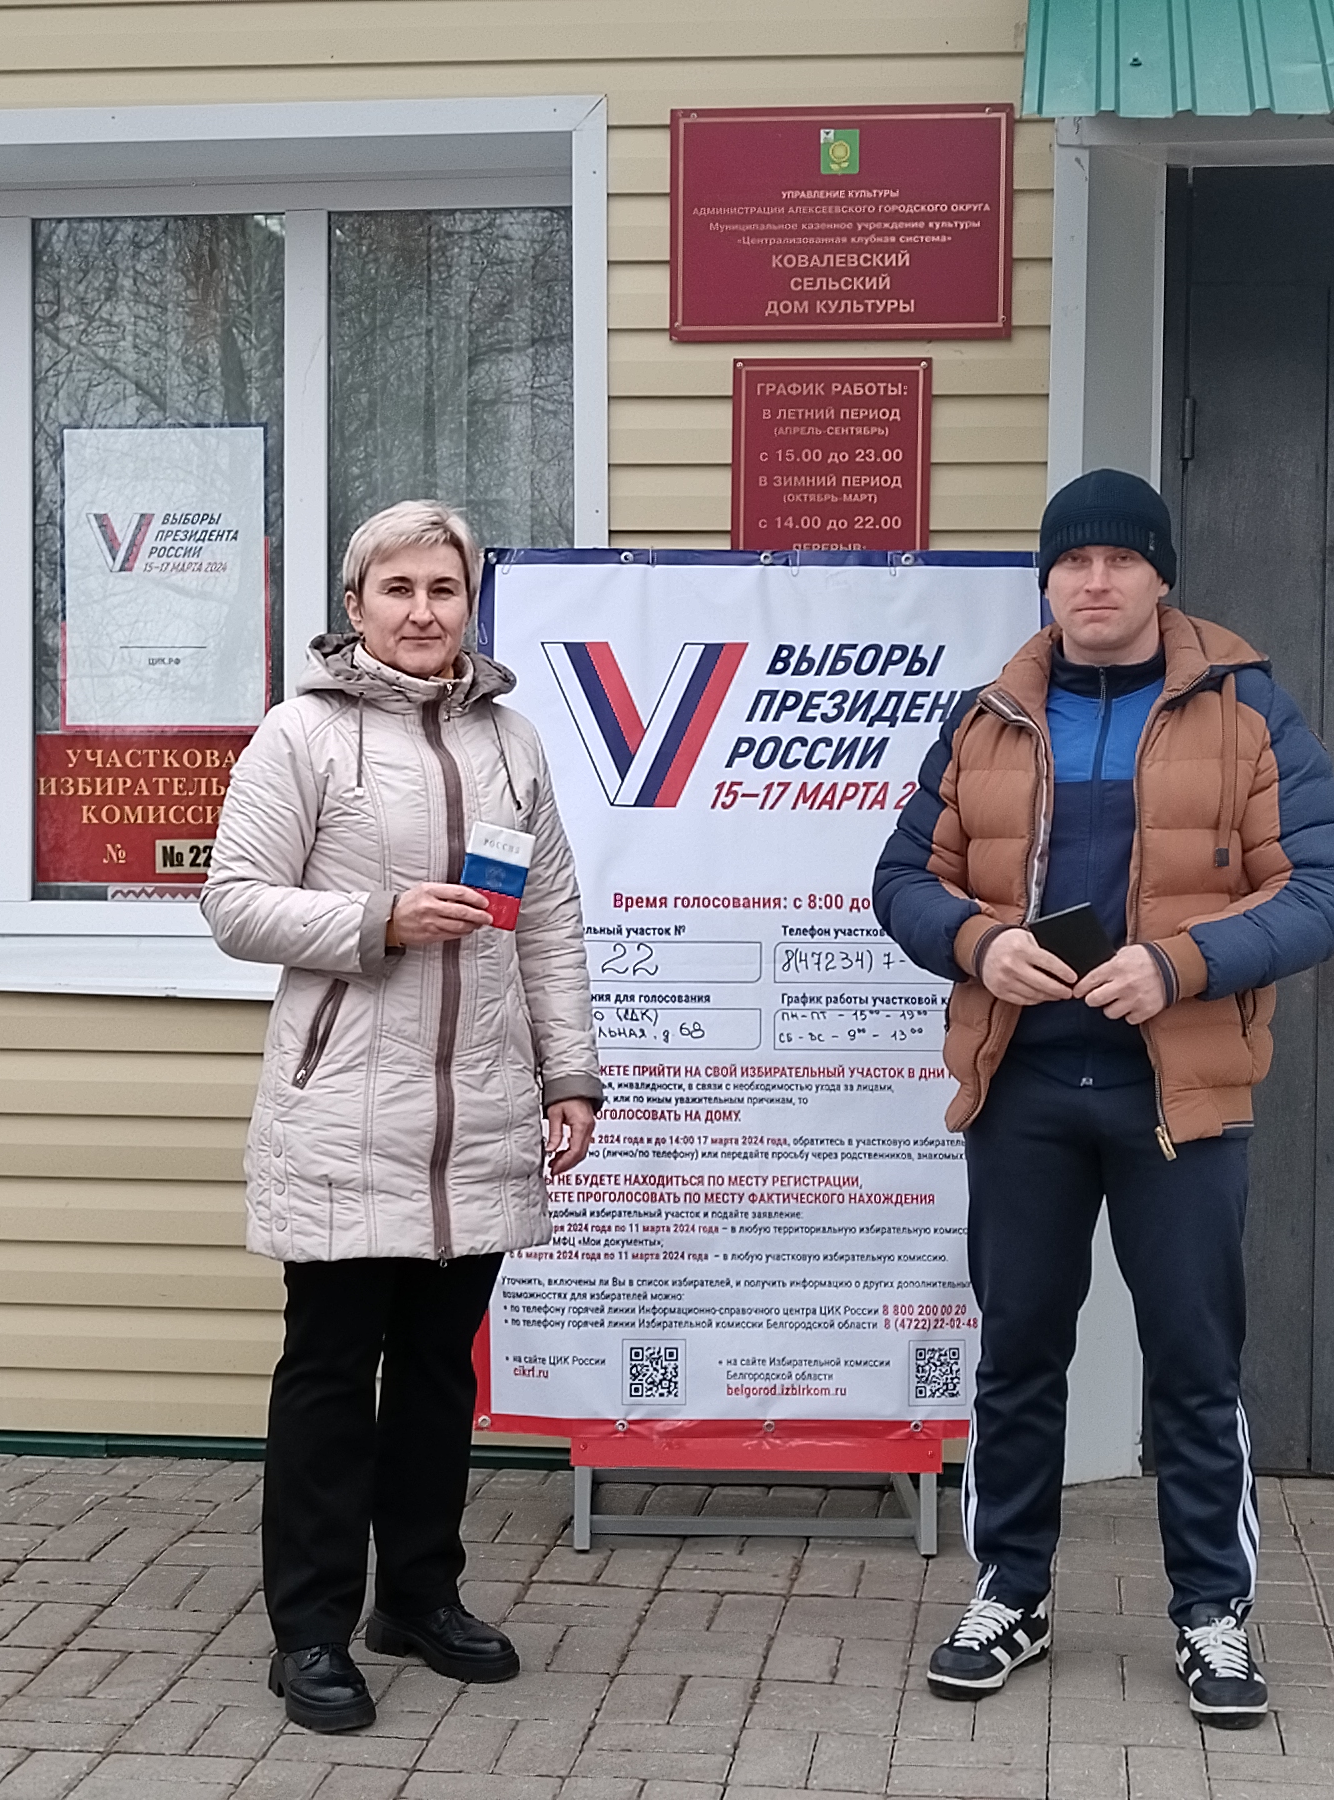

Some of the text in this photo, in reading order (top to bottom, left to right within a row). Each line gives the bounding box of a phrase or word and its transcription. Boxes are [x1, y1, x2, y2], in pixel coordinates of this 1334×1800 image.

[782, 189, 899, 199] УПРАВЛЕНИЕ КУЛЬТУРЫ
[693, 203, 990, 216] АДМИНИСТРАЦИИ АЛЕКСЕЕВСКОГО ГОРОДСКОГО ОКРУГА
[709, 219, 981, 232] Муниципальное казенное учреждение культуры
[851, 234, 896, 245] клубная
[900, 234, 952, 243] система»
[772, 251, 910, 268] КОВАЛЕВСКИЙ
[790, 274, 891, 290] СЕЛЬСКИЙ
[765, 299, 915, 316] ДОМ КУЛЬТУРЫ
[757, 383, 908, 396] ГРАФИК РАБОТЫ:
[763, 407, 900, 421] В ЛЕТНИЙ ПЕРИОД
[774, 426, 888, 436] (АПРЕЛЬ-СЕНТЯБРЬ)
[760, 449, 903, 464] с 15.00 до 23.00
[759, 474, 902, 488] В ЗИМНИЙ ПЕРИОД
[783, 493, 877, 503] (ОКТЯБРЬ-МАРТ)
[162, 513, 222, 525] ВЫБОРЫ
[759, 516, 902, 531] с 14.00 до 22.00
[155, 530, 239, 542] ПРЕЗИДЕНТА
[148, 547, 203, 558] РОССИИ
[171, 562, 203, 572] МАРТА
[205, 562, 227, 572] 2024
[767, 644, 945, 677] ВЫБОРЫ
[746, 690, 958, 728] ПРЕЗИДЕН
[66, 749, 237, 768] УЧАСТКОВА
[726, 737, 890, 769] РОССИИ
[39, 778, 226, 796] ИЗБИРАТЕЛЬ
[792, 781, 889, 811] МАРТА
[81, 805, 221, 824] КОМИССИ
[484, 838, 520, 854] РОССИЯ
[103, 844, 126, 863] №
[162, 846, 184, 867] №
[614, 893, 870, 912] Время голосования: с 8:00 до
[626, 925, 685, 938] участок №
[782, 925, 830, 938] Телефон
[601, 943, 658, 976] 22
[615, 994, 710, 1004] для голосования
[782, 993, 937, 1006] График работы участковой
[680, 1022, 705, 1039] 68
[633, 1064, 944, 1080] ПРИЙТИ НА СВОЙ ИЗБИРАТЕЛЬНЫЙ УЧАСТОК В ДНИ
[618, 1080, 894, 1093] инвалидности, необходимостью лицами,
[675, 1096, 744, 1105] уважительным
[685, 1110, 741, 1124] НА ДОМУ.
[793, 1136, 845, 1147] обратитесь
[652, 1148, 914, 1162] телефону) просьбу родственников,
[575, 1174, 862, 1189] БУДЕТЕ НАХОДИТЬСЯ ПО МЕСТУ РЕГИСТРАЦИИ,
[577, 1192, 935, 1206] ПРОГОЛОСОВАТЬ ПО МЕСТУ ФАКТИЧЕСКОГО НАХОЖДЕНИЯ
[589, 1209, 803, 1220] избирательный участок подайте заявление:
[774, 1225, 930, 1236] территориальную избирательную
[553, 1238, 664, 1249] МФЦ «Мои документы»;
[663, 1251, 948, 1264] 2024 участковую избирательную комиссию.
[501, 1276, 852, 1289] Уточнить, включены список избирателей, получить информацию
[503, 1291, 684, 1303] возможностях избирателей можно:
[522, 1303, 938, 1318] телефону горячей Информационно-справочного ЦИК России 800 200
[523, 1318, 978, 1332] телефону горячей Избирательной комиссии Белгородской области (4722) 22-02-48
[549, 1356, 606, 1366] ЦИК России
[740, 1357, 891, 1369] сайте Избирательной комиссии
[514, 1366, 549, 1379] cikrf.ru
[727, 1370, 833, 1382] Белгородской области
